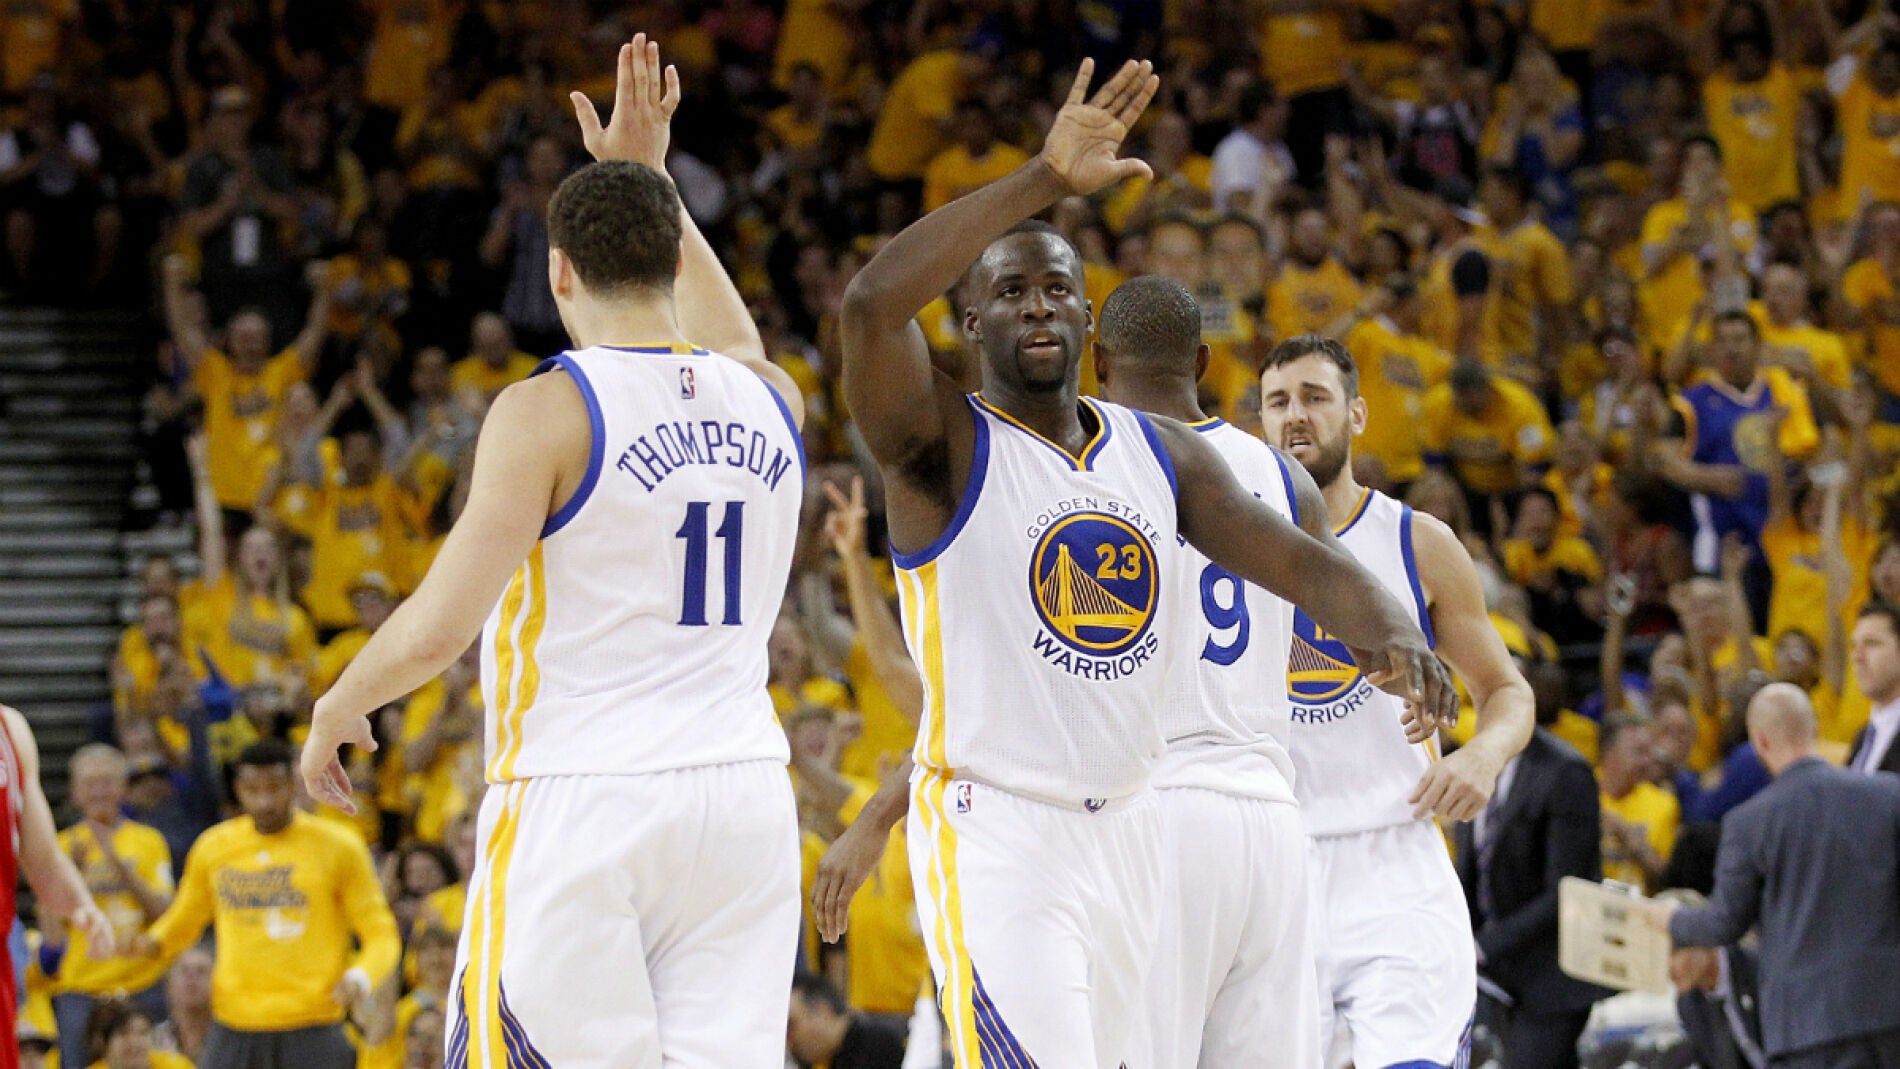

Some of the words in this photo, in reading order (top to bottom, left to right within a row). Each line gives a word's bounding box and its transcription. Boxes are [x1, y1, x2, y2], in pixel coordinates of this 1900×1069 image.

[616, 420, 792, 493] THOMPSON
[1027, 497, 1098, 540] GOLDEN
[1107, 501, 1161, 546] STATE
[675, 501, 746, 626] 11
[1095, 543, 1142, 581] 23
[1199, 562, 1250, 666] 9
[1032, 629, 1159, 681] WARRIORS
[1290, 682, 1374, 725] RRIORS
